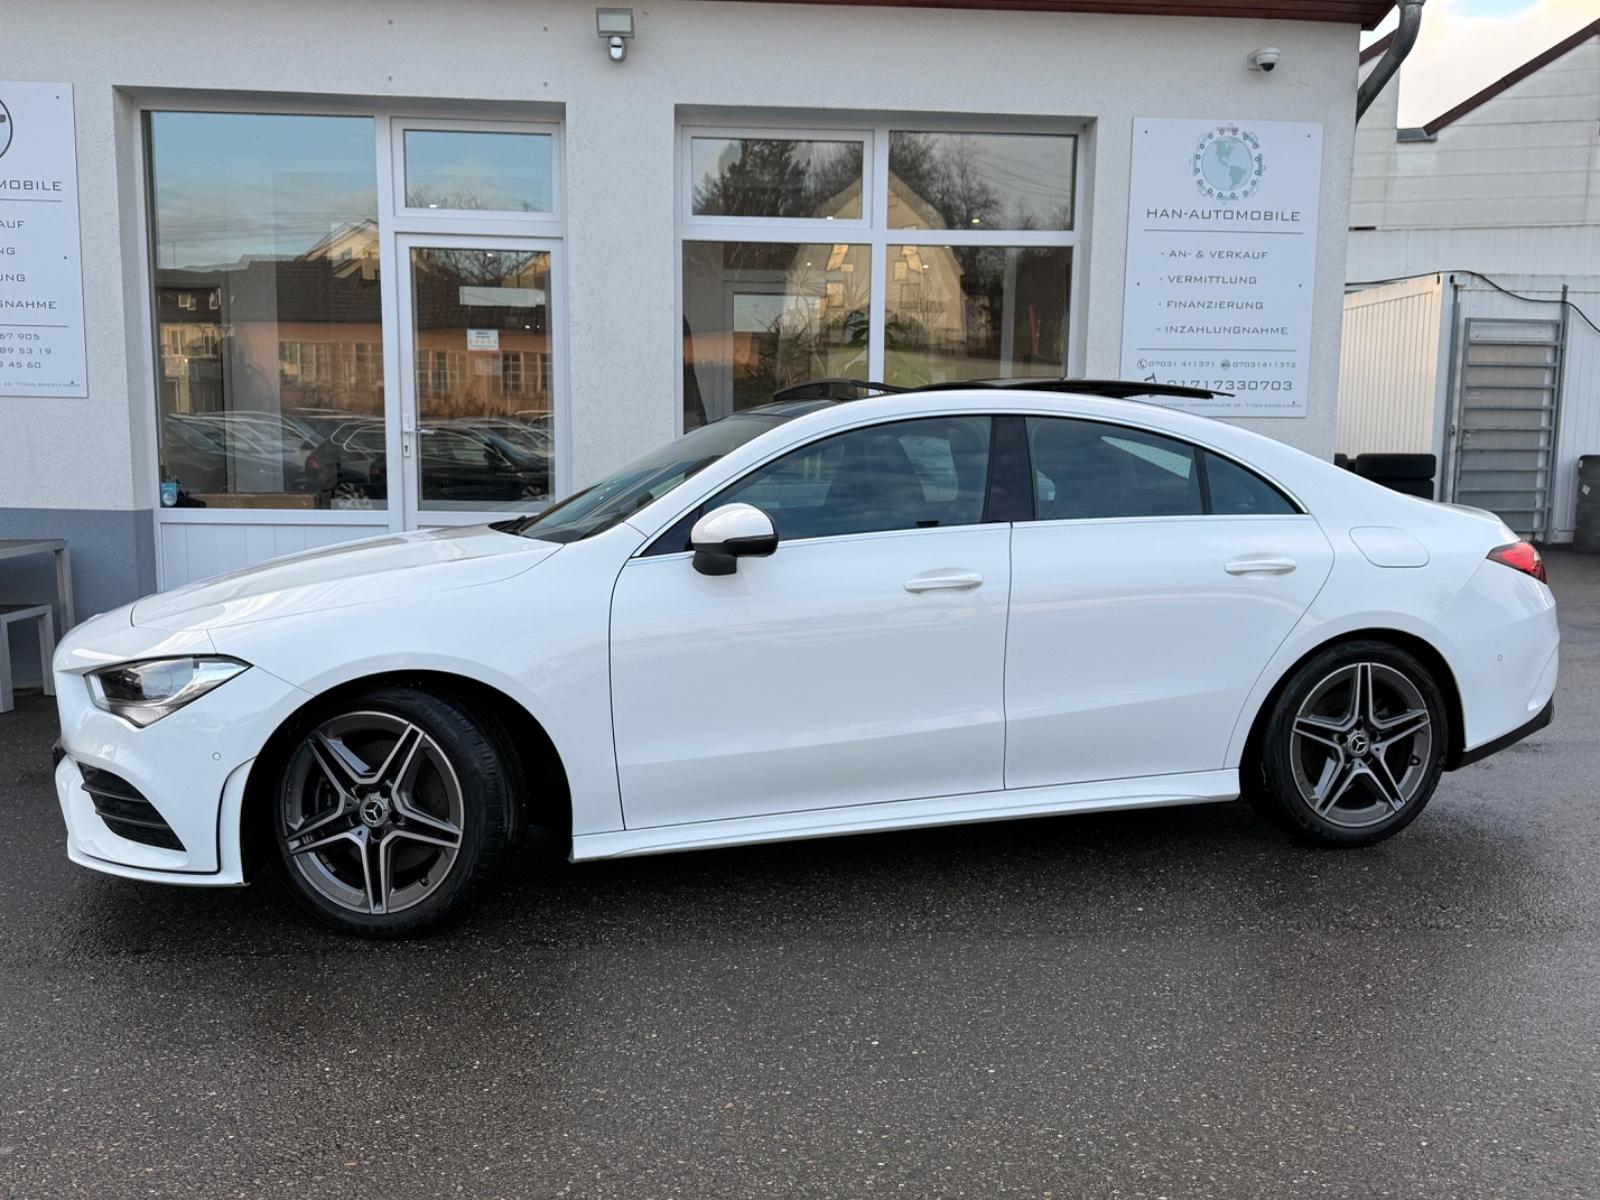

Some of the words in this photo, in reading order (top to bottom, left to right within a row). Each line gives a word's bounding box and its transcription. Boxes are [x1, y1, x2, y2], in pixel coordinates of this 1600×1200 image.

[1146, 208, 1301, 222] HAN-AUTOMOBILE
[1195, 250, 1204, 259] &
[1209, 250, 1269, 260] VERKAUF
[1167, 275, 1257, 285] VERMITTLUNG
[1166, 300, 1264, 310] FINANZIERUNG
[1165, 325, 1289, 335] INZAHLUNGNAHME
[17, 332, 40, 340] 905
[18, 346, 33, 354] 53
[39, 346, 52, 355] 19
[8, 361, 23, 369] 45
[26, 361, 41, 369] 60
